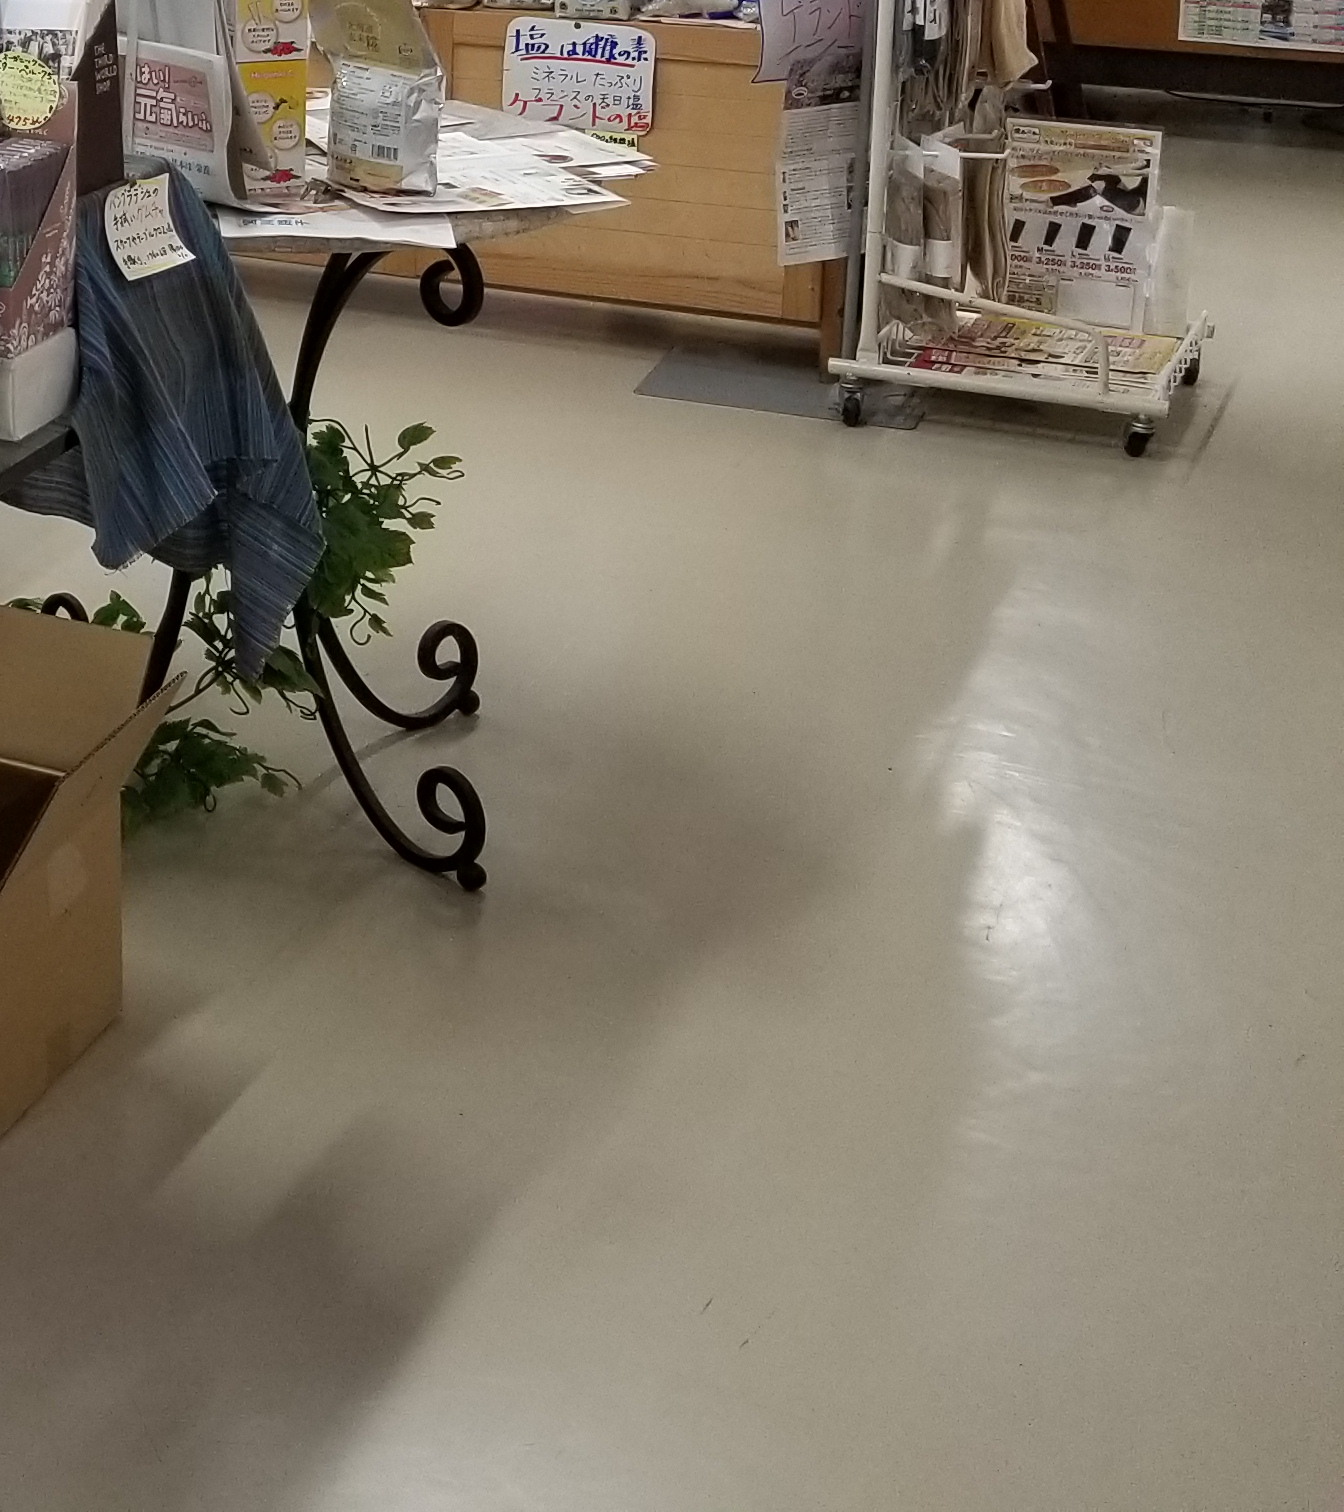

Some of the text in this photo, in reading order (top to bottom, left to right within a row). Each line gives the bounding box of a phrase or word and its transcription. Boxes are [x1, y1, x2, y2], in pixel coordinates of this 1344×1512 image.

[135, 62, 171, 88] はい!
[530, 66, 645, 93] ミネラル たっぷり
